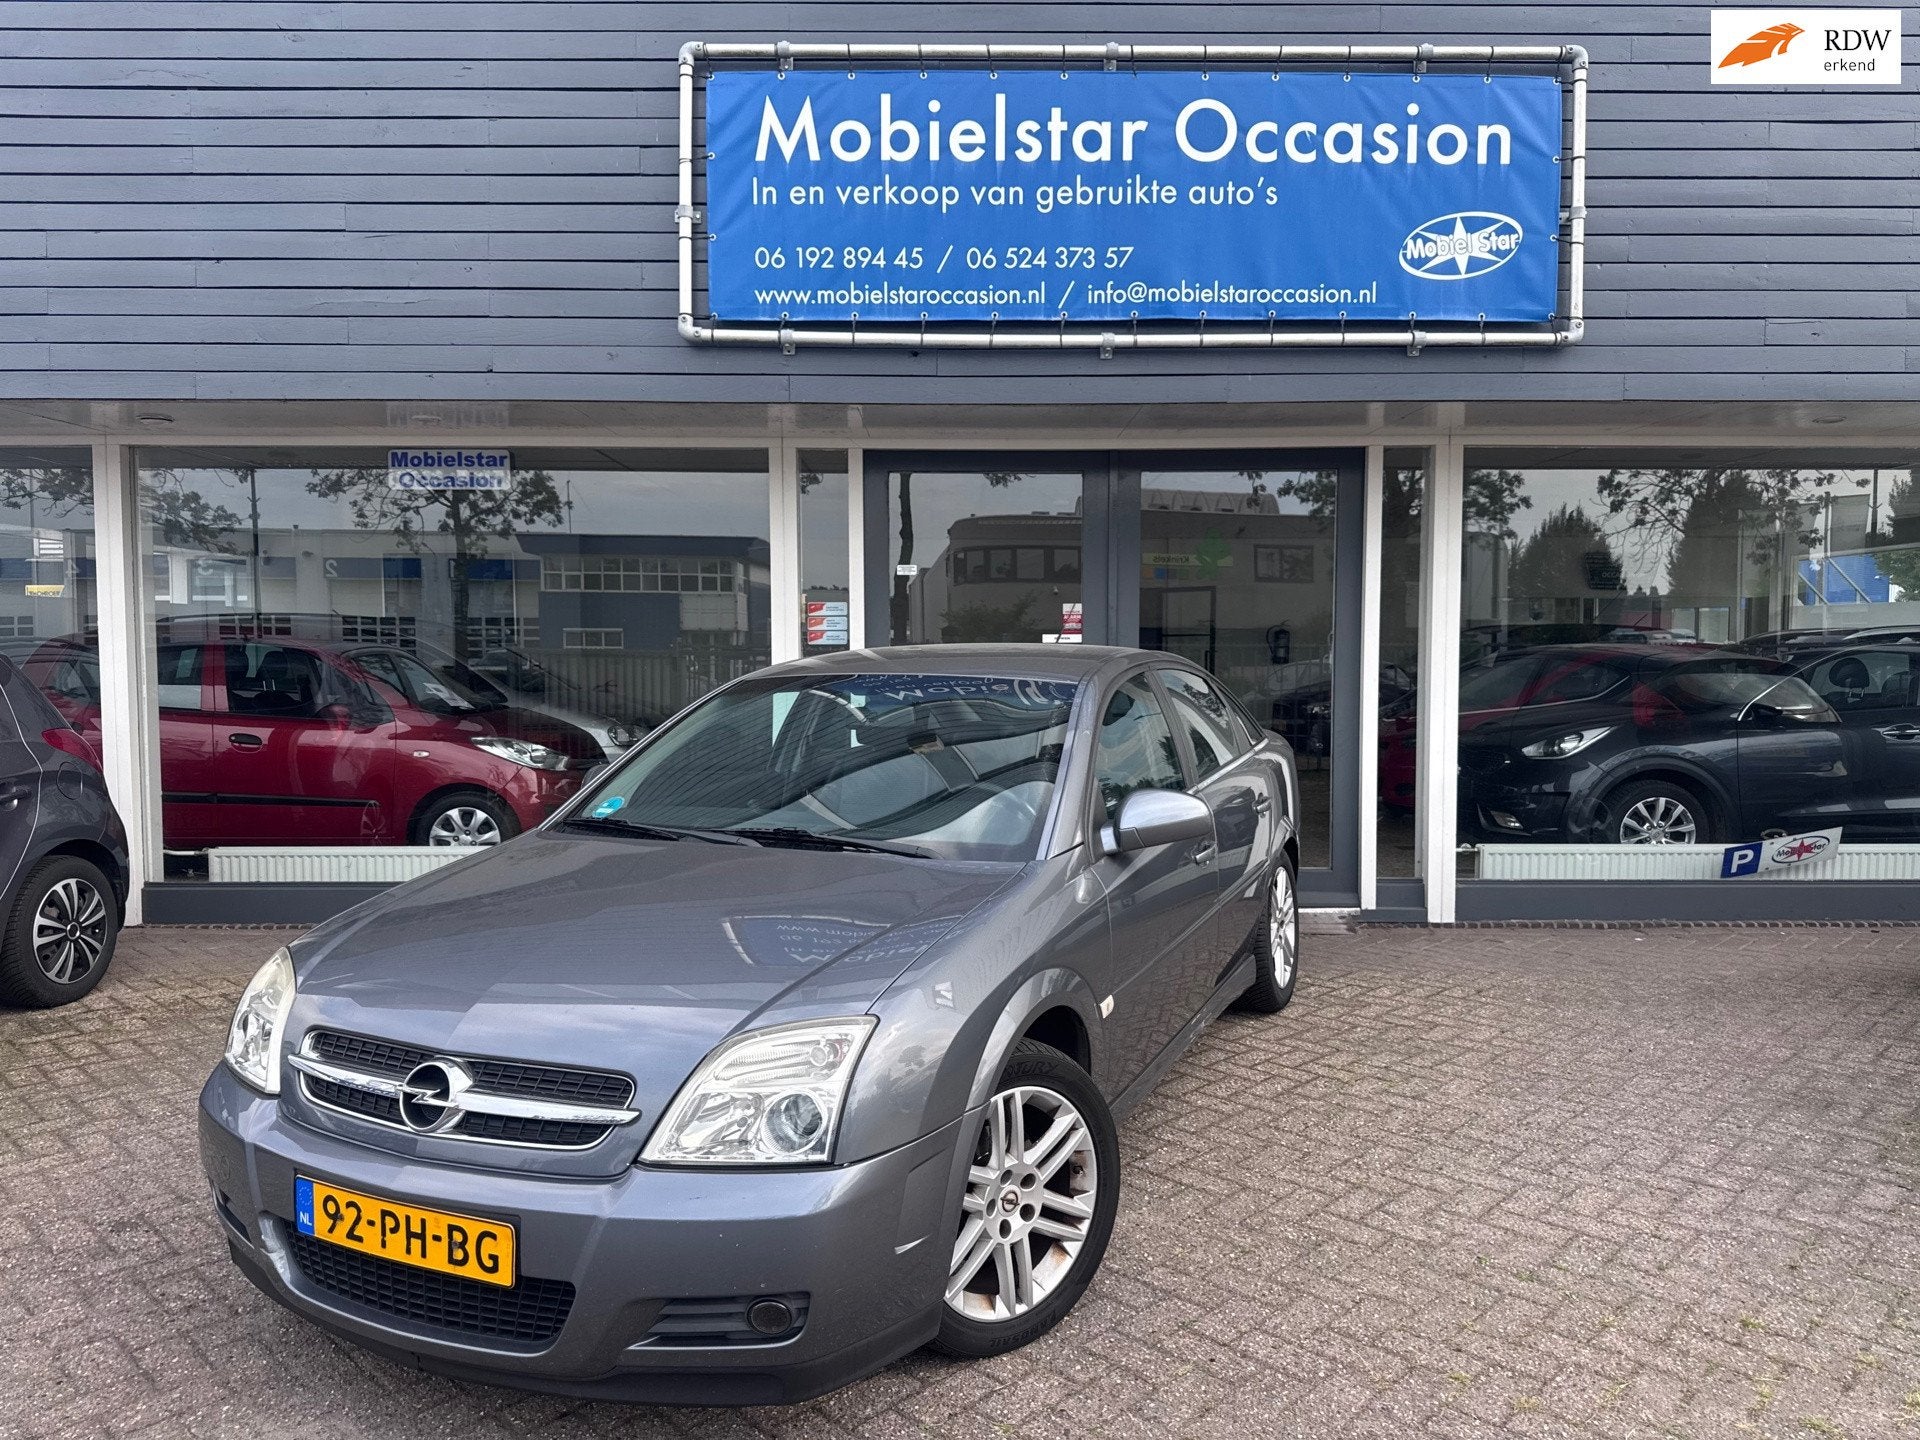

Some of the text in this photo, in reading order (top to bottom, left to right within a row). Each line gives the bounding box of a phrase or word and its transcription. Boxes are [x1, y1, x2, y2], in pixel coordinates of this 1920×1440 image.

[755, 93, 1511, 165] Mobielstar Occasion
[752, 177, 777, 205] In
[789, 184, 824, 205] en
[835, 176, 960, 213] verkoop
[970, 184, 1024, 205] van
[1036, 175, 1177, 211] gebruikte
[754, 247, 786, 270] 06
[796, 247, 834, 270] 192
[843, 247, 887, 269] 894
[894, 247, 923, 269] 45
[966, 247, 997, 269] 06
[1004, 247, 1047, 269] 524
[1055, 246, 1096, 269] 373
[1104, 246, 1134, 268] 57
[1406, 231, 1519, 260] Mobiel Star
[754, 281, 1046, 305] www.mobielstaroccasion.nl
[1087, 279, 1377, 304] info@mobielstaroccasion.nl
[390, 452, 508, 468] Mobielstar
[399, 471, 503, 488] Occasion
[1730, 849, 1754, 874] P
[299, 1211, 313, 1227] NL
[322, 1194, 500, 1274] 92-PH-BG
